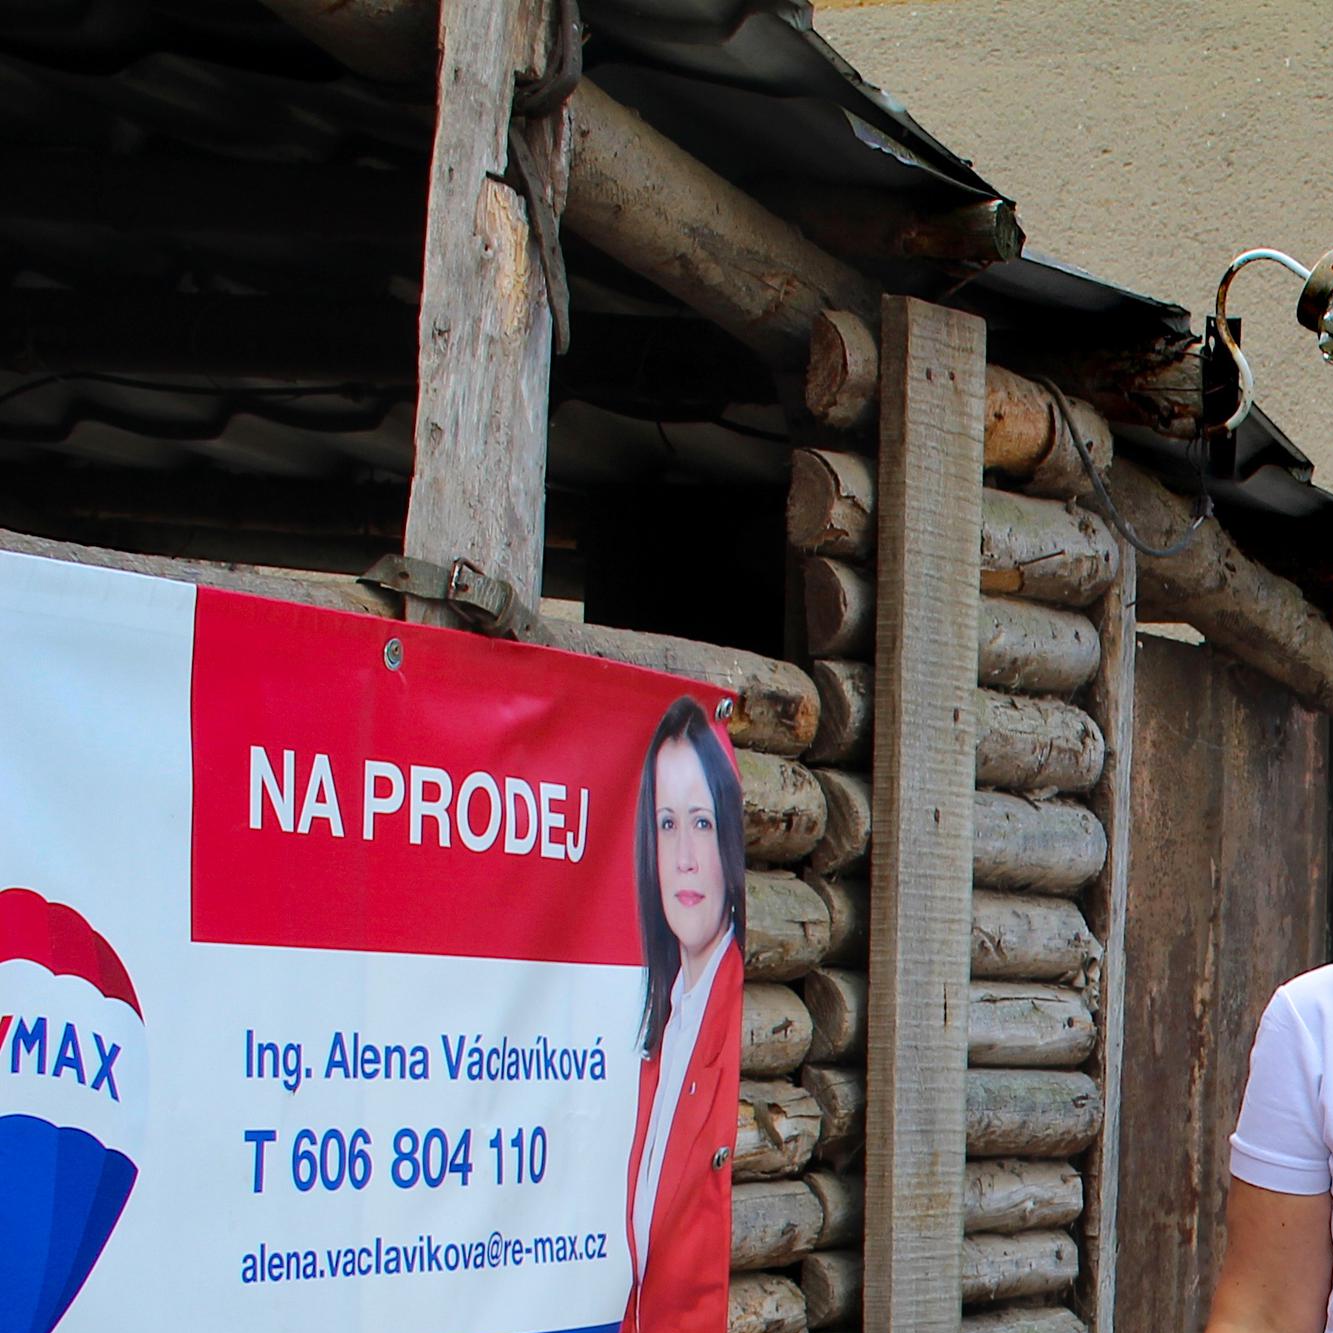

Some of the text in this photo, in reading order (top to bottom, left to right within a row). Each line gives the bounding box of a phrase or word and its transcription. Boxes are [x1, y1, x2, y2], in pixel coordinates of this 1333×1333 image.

[249, 745, 589, 863] NA PRODEJ
[245, 1029, 607, 1091] Ing. Alena Václavíková
[244, 1126, 547, 1193] T 606 804 110
[241, 1231, 607, 1284] alena.vaclavikova@re-max.cz
